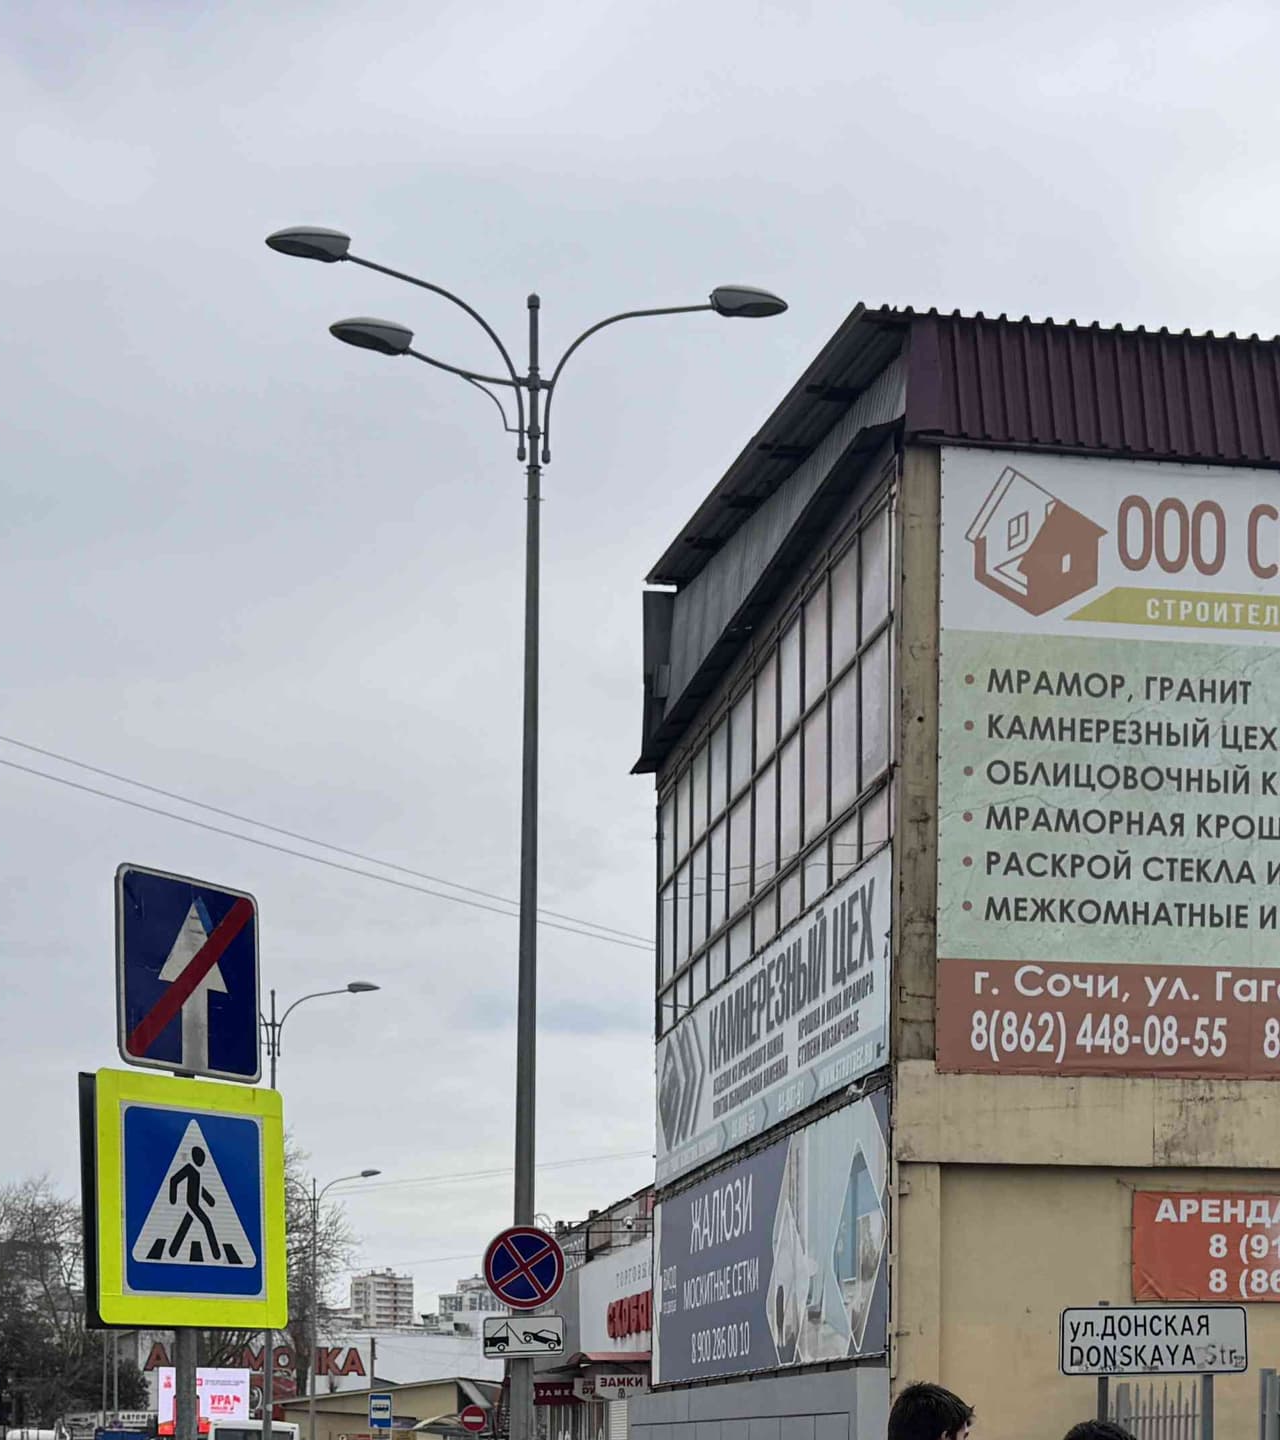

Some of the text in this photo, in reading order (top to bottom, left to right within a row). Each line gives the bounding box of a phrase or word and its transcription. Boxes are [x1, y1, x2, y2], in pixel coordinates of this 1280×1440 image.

[1118, 495, 1226, 576] ООО
[987, 668, 1252, 705] МРАМОР, ГРАНИТ
[987, 714, 1279, 753] КАМНЕРЕЗНЫЙ ЦЕХ
[986, 759, 1251, 796] ОБЛИЦОВОЧНЫЙ
[985, 806, 1185, 838] МРАМОРНАЯ
[985, 850, 1132, 882] РАСКРОЙ
[1142, 855, 1257, 885] СТЕКЛА
[984, 896, 1249, 929] МЕЖКОМНАТНЫЕ
[1259, 905, 1277, 930] И
[708, 876, 875, 1075] КАМНЕРЕЗНЫЙ ЦЕХ
[974, 971, 1000, 996] г.
[1013, 965, 1130, 1003] Сочи,
[1144, 975, 1201, 1008] ул.
[970, 1009, 1067, 1065] 8(862)
[1075, 1012, 1228, 1058] 448-08-55
[690, 1174, 753, 1255] ЖАЛЮЗИ
[1209, 1234, 1228, 1258] 8
[683, 1256, 759, 1311] МОСКИТНЫЕ СЕТКИ
[1208, 1268, 1228, 1293] 8
[1070, 1344, 1196, 1367] DONSKAYA
[210, 1394, 232, 1406] УРА
[600, 1377, 644, 1388] ЗАМКИ
